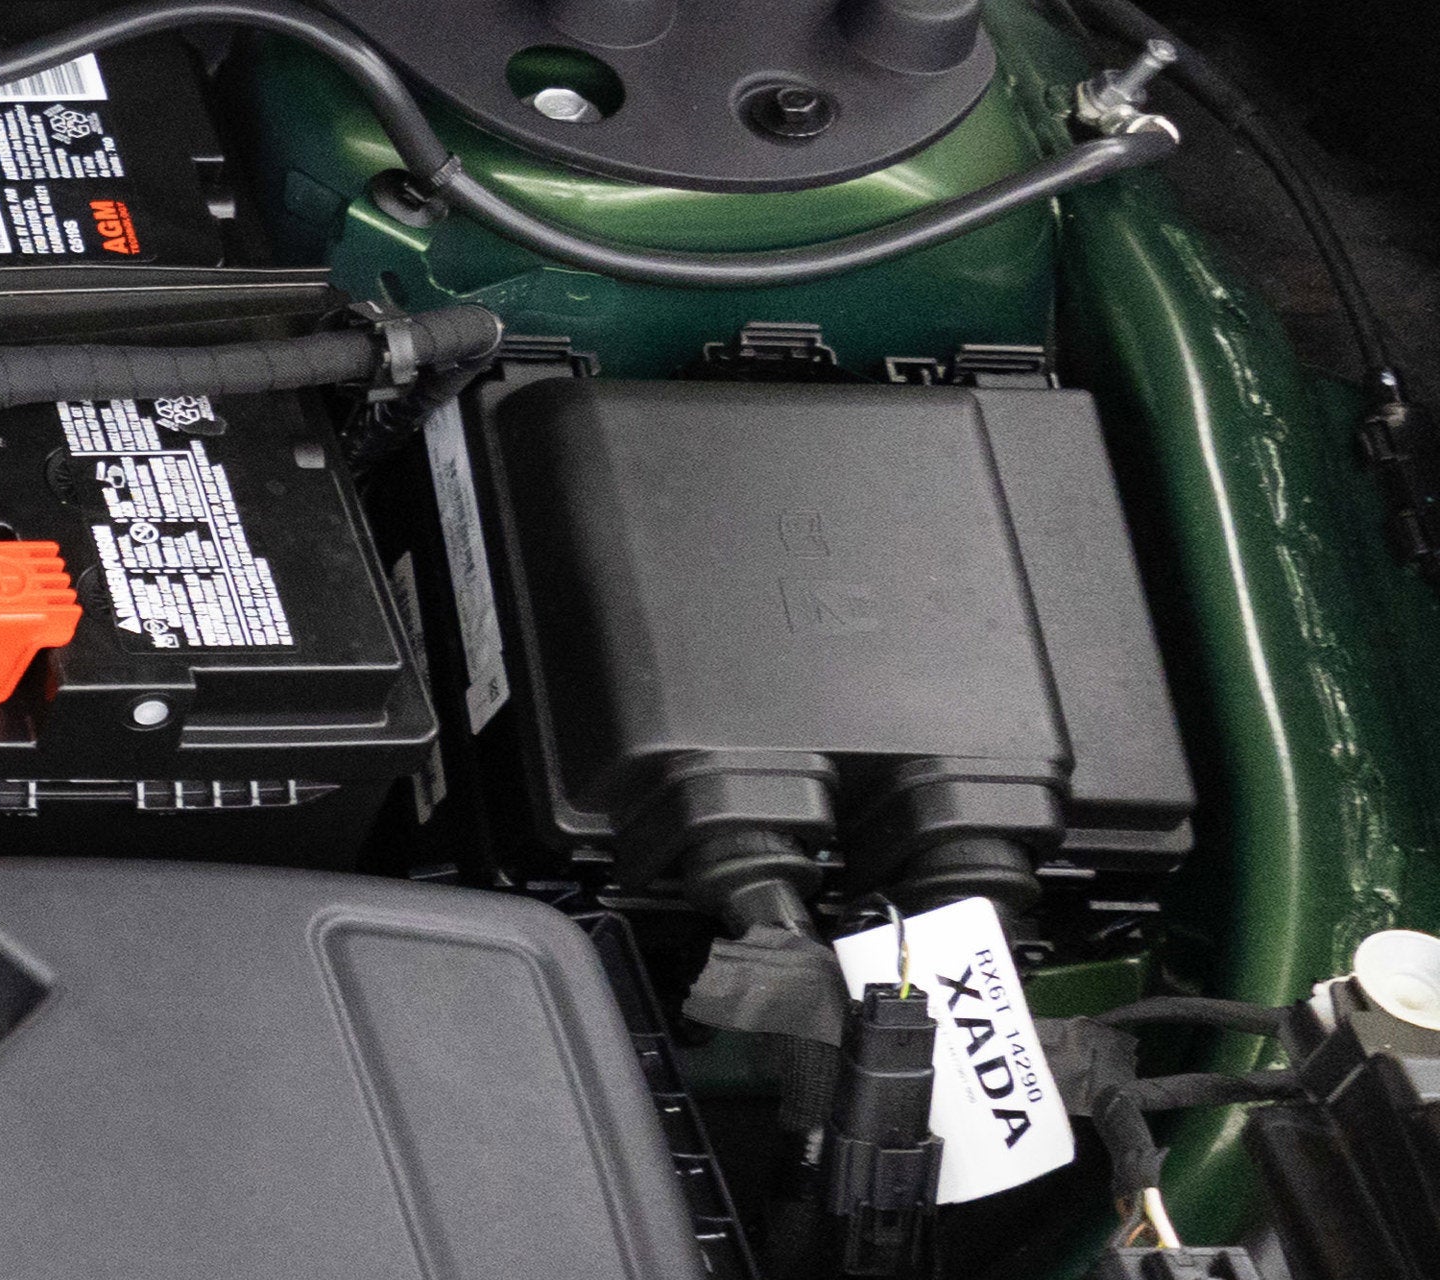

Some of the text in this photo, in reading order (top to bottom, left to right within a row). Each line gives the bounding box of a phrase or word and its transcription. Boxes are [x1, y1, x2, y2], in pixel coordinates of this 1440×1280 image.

[89, 199, 129, 253] AGM
[116, 201, 140, 254] TECHNOLOGY
[936, 964, 1033, 1149] XADA
[975, 948, 1043, 1104] RX6T 14290
